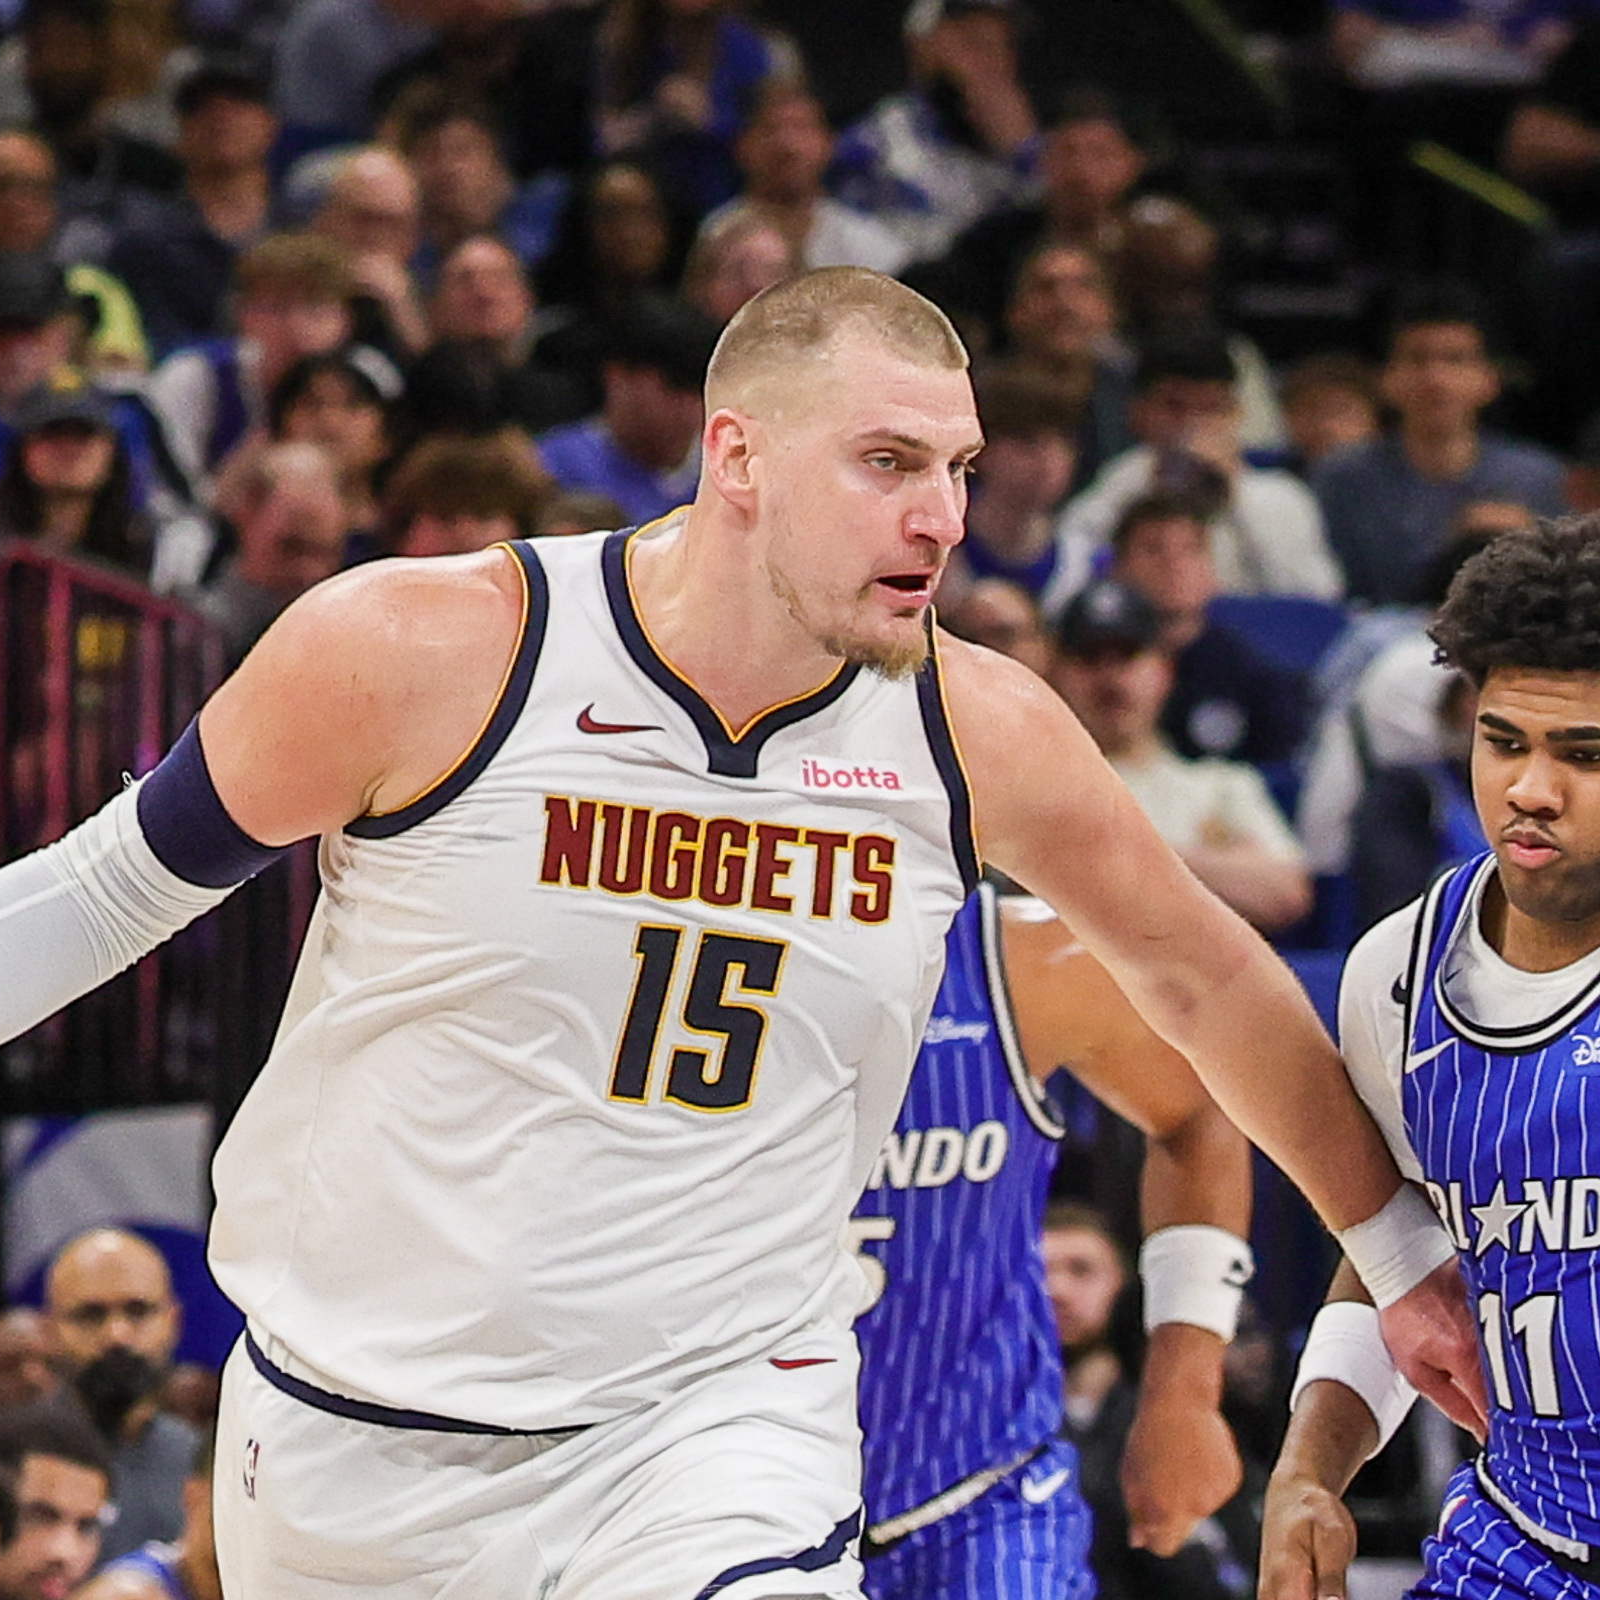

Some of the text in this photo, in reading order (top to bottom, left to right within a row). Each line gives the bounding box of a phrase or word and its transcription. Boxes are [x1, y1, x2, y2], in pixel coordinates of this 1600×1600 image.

[802, 760, 903, 791] ibotta
[539, 794, 901, 926] NUGGETS
[606, 922, 791, 1114] 15
[1477, 1291, 1563, 1418] 11
